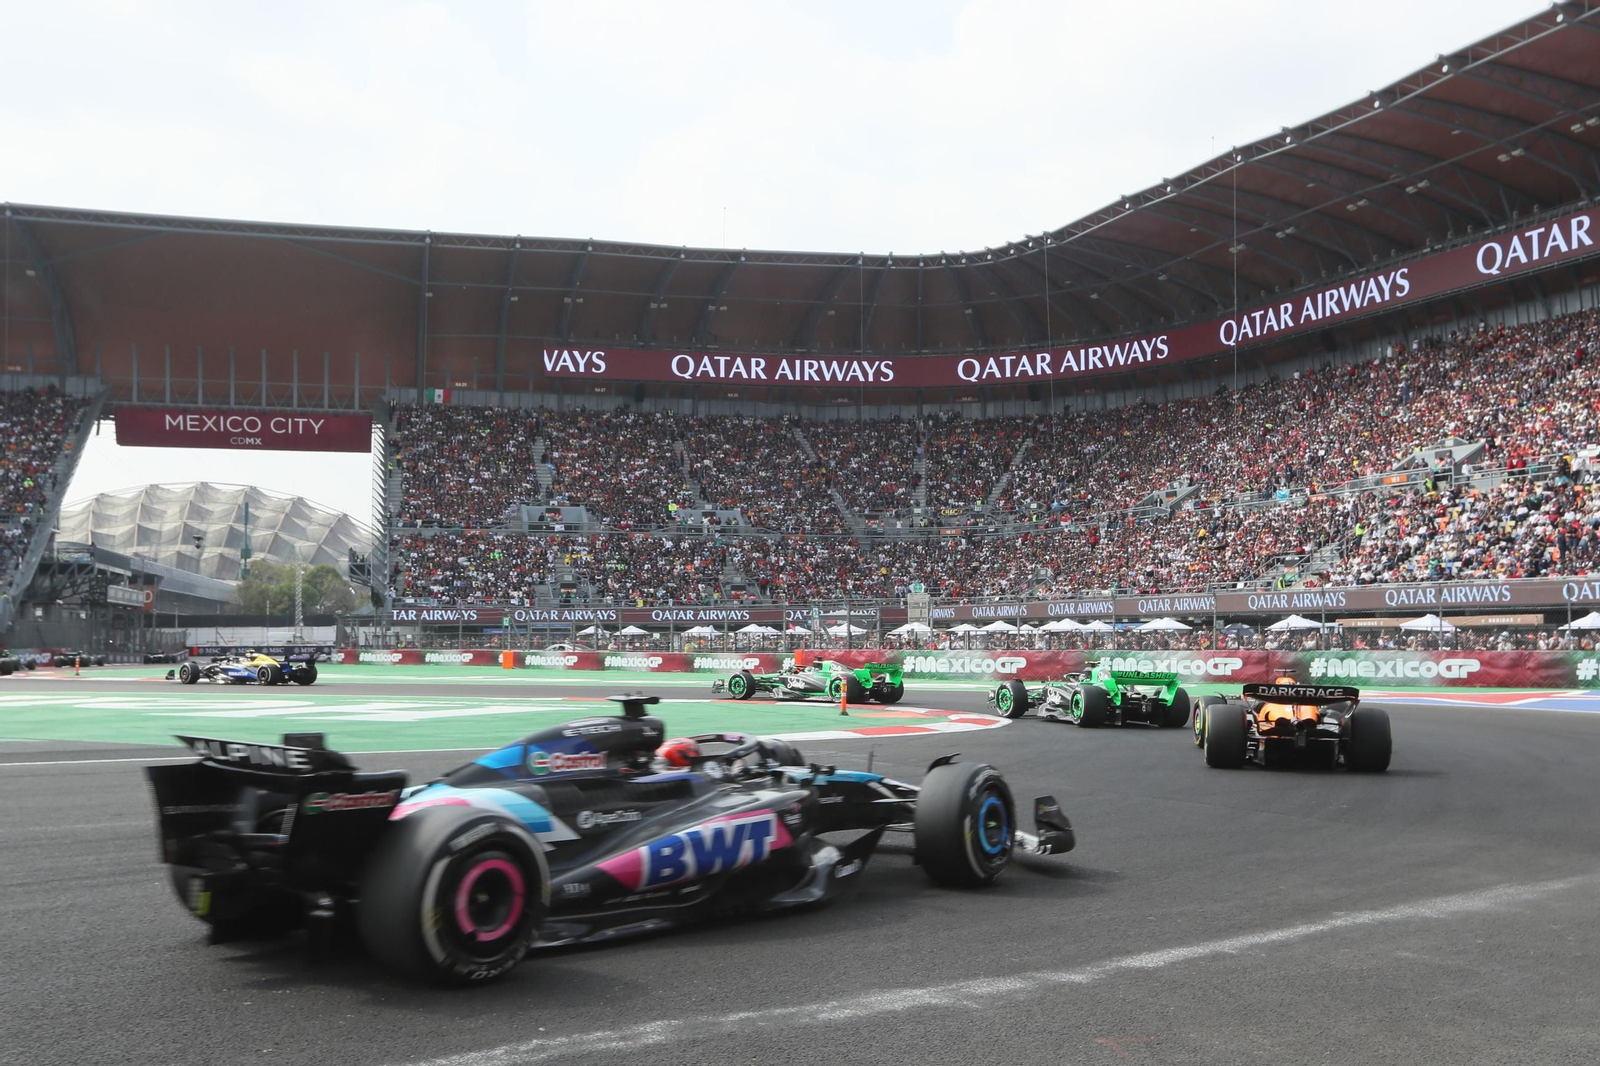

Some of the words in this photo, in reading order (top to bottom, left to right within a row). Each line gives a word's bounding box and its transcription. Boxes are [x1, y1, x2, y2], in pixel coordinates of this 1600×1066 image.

[1476, 215, 1593, 275] QATAR
[1219, 302, 1294, 346] QATAR
[1300, 268, 1410, 324] AIRWAYS
[957, 353, 1052, 382] QATAR
[1060, 335, 1169, 373] AIRWAYS
[671, 354, 768, 380] QATAR
[774, 359, 894, 382] AIRWAYS
[165, 414, 262, 433] MEXICO
[270, 417, 325, 435] CITY
[230, 437, 262, 445] CDMX
[1248, 594, 1289, 610] QATAR
[1291, 591, 1346, 608] AIRWAYS
[1385, 587, 1438, 607] QATAR
[1440, 585, 1511, 604] AIRWAYS
[972, 607, 995, 618] QATAR
[996, 605, 1027, 617] AIRWAYS
[1047, 603, 1075, 616] QATAR
[1077, 601, 1113, 614] AIRWAYS
[1138, 600, 1170, 612] QATAR
[1172, 597, 1216, 611] AIRWAYS
[420, 610, 477, 620] AIRWAYS
[514, 609, 558, 621] QATAR
[562, 609, 617, 620] AIRWAYS
[652, 610, 697, 622] QATAR
[697, 610, 750, 620] AIRWAYS
[359, 652, 402, 662] #MexicoGP
[425, 653, 473, 663] #MexicoGP
[525, 655, 578, 666] #MexicoGP
[604, 656, 662, 667] #MexicoGP
[693, 657, 760, 669] #MexicoGP
[903, 655, 1027, 673] #MexicoGP
[1100, 657, 1243, 675] #MexicoGP
[1309, 657, 1481, 679] #MexicoGP
[1258, 685, 1343, 697] DARKTRACE
[193, 739, 313, 769] ALPINE
[643, 813, 778, 889] BWT
